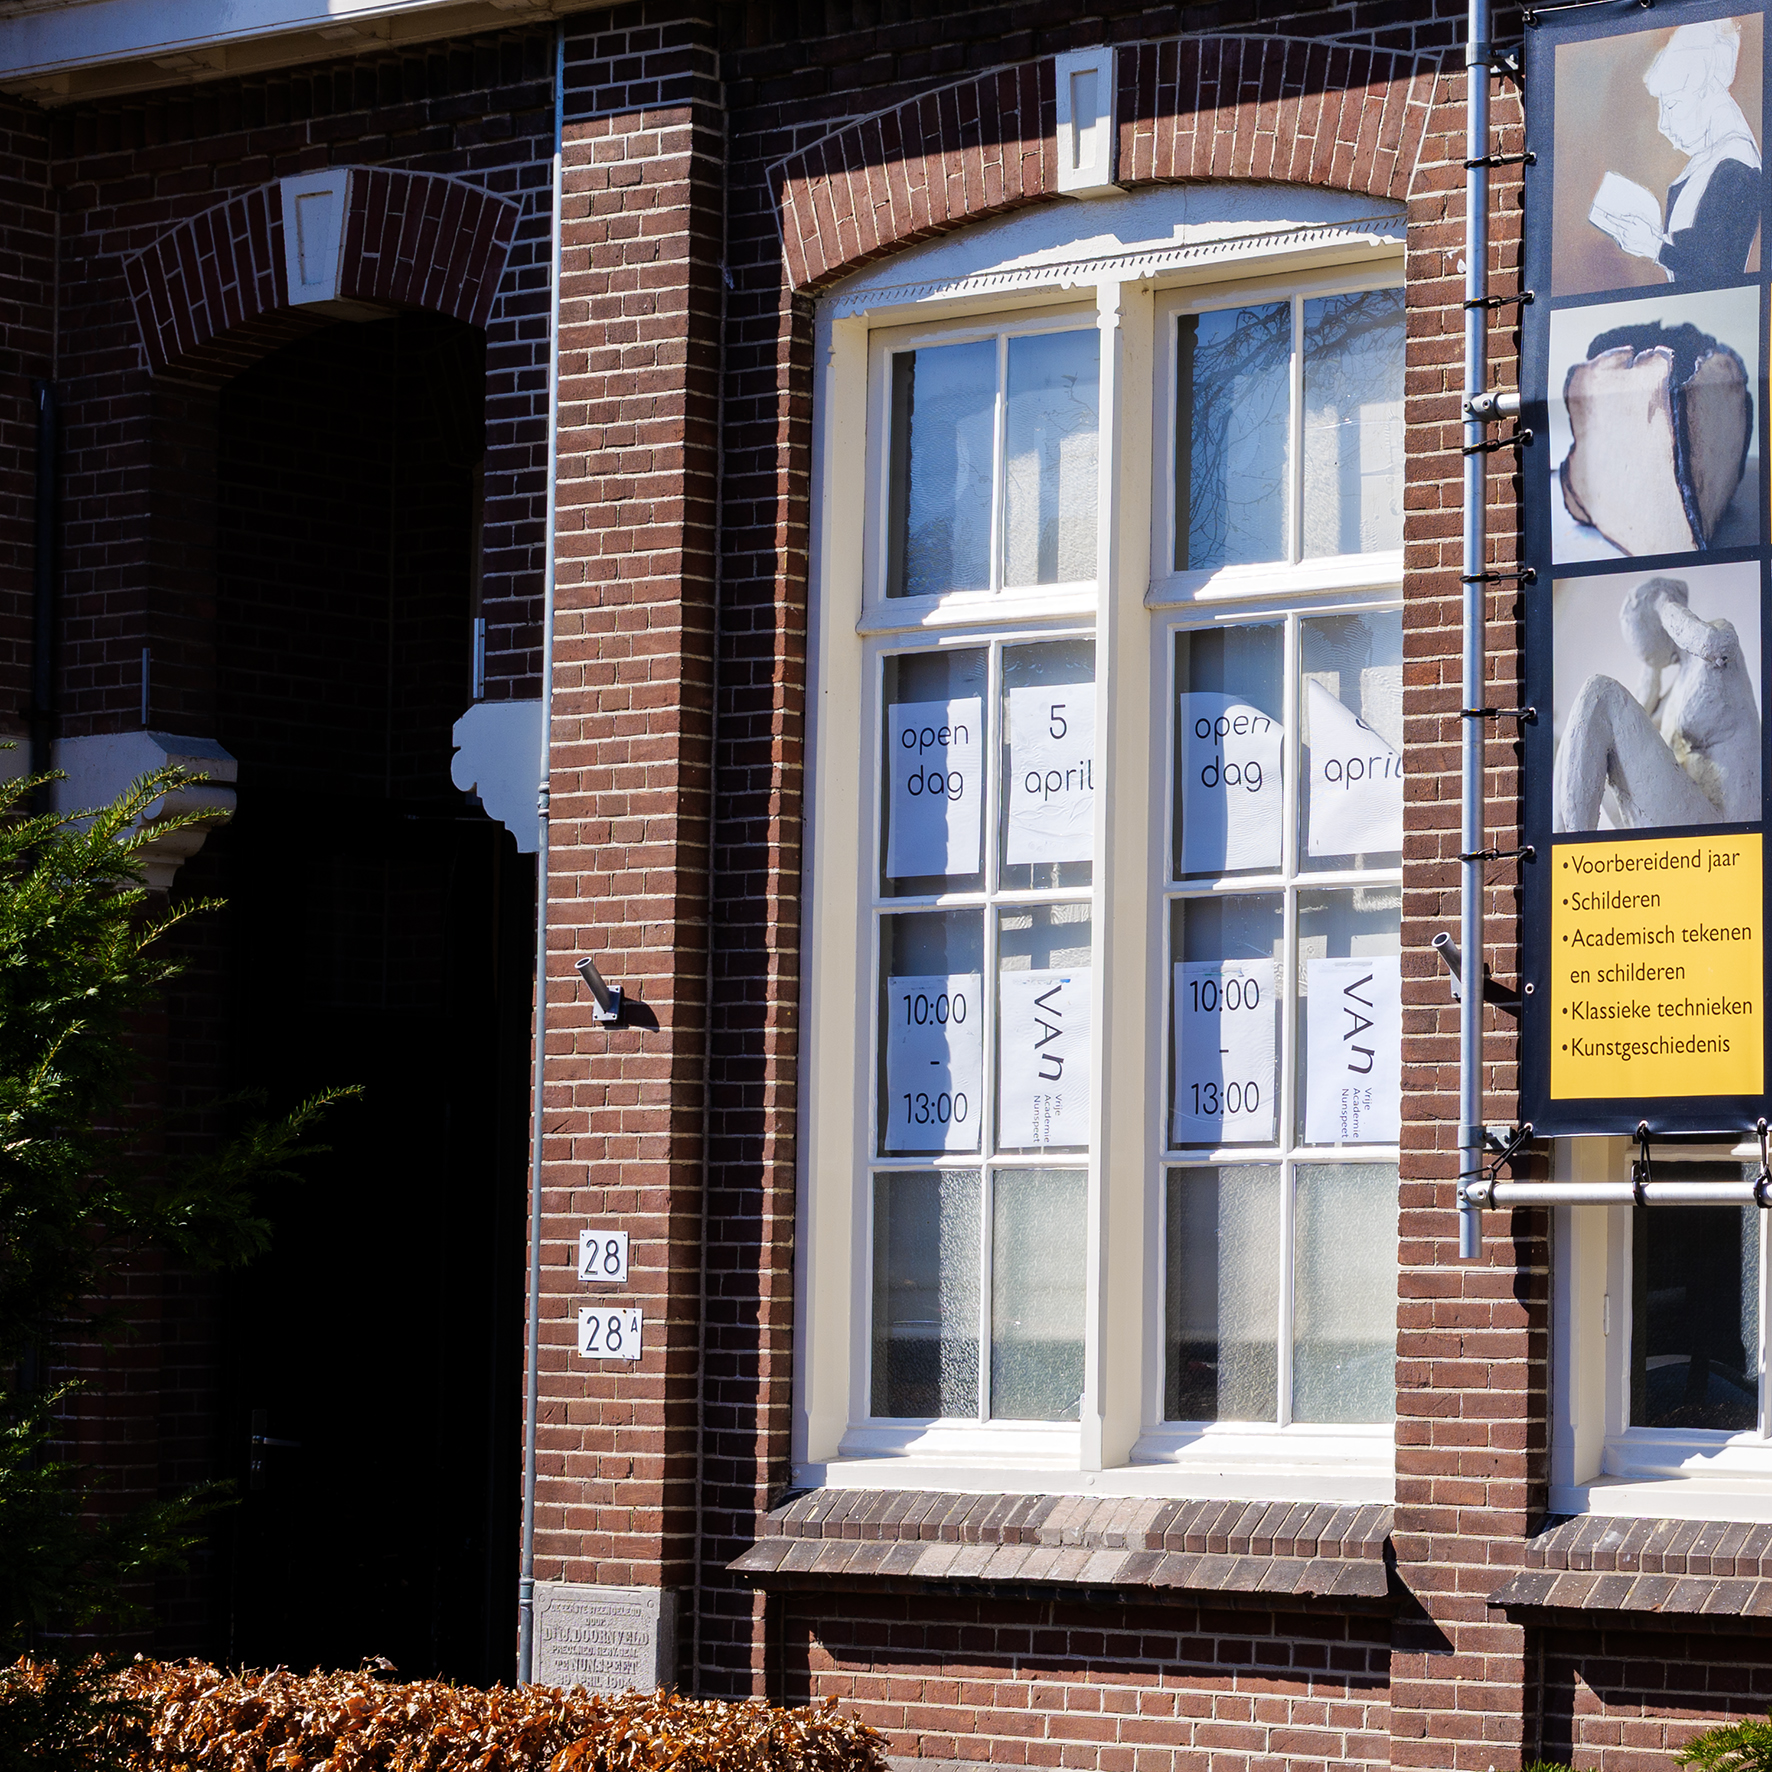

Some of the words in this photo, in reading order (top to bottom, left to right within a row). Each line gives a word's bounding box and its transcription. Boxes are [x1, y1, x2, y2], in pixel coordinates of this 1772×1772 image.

[1050, 705, 1067, 739] 5
[1196, 716, 1270, 745] open
[902, 725, 968, 755] open
[908, 765, 963, 800] dag
[1025, 760, 1094, 801] april
[1202, 755, 1262, 792] dag
[1325, 752, 1401, 790] april
[1571, 849, 1701, 874] Voorbereidend
[1708, 850, 1740, 872] jaar
[1571, 891, 1661, 910] Schilderen
[1571, 926, 1675, 947] Academisch
[1682, 924, 1751, 942] tekenen
[1571, 969, 1590, 983] en
[1597, 963, 1685, 982] schilderen
[904, 993, 966, 1025] 10:00
[1190, 979, 1259, 1012] 10:00
[1571, 1000, 1650, 1020] Klassieke
[1657, 997, 1752, 1017] technieken
[1035, 985, 1064, 1081] VAn
[1343, 974, 1375, 1074] VAn
[1571, 1035, 1730, 1060] Kunstgeschiedenis
[904, 1093, 968, 1124] 13:00
[1053, 1094, 1062, 1116] Vrije
[1191, 1082, 1259, 1115] 13:00
[1341, 1089, 1349, 1138] Nunspeet
[1364, 1088, 1372, 1111] Vrije
[584, 1239, 620, 1275] 28
